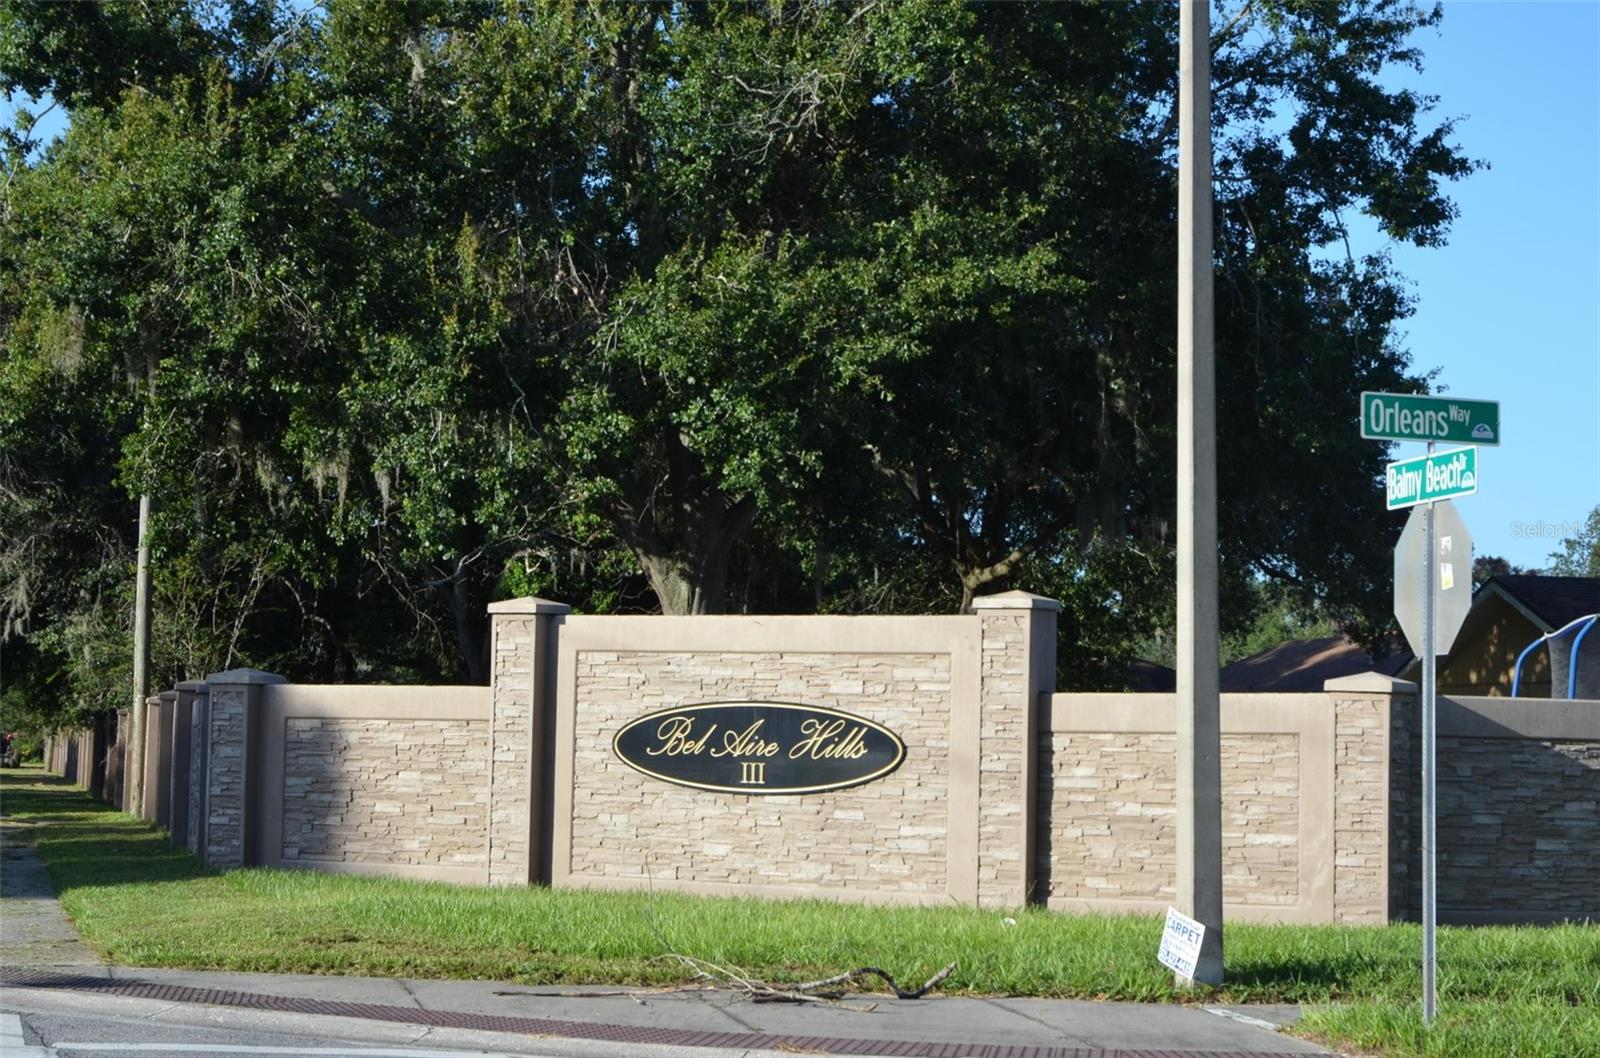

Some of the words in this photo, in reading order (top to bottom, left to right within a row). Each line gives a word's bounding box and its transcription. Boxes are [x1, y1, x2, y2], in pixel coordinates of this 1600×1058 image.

[1370, 398, 1449, 436] Orleans
[1448, 404, 1471, 426] Way
[1389, 465, 1422, 501] Balmy
[1426, 459, 1461, 493] Beach
[647, 716, 717, 757] Bel
[711, 718, 779, 758] Aire
[789, 719, 868, 760] Hills
[740, 762, 765, 784] III
[1167, 916, 1201, 945] CARPET
